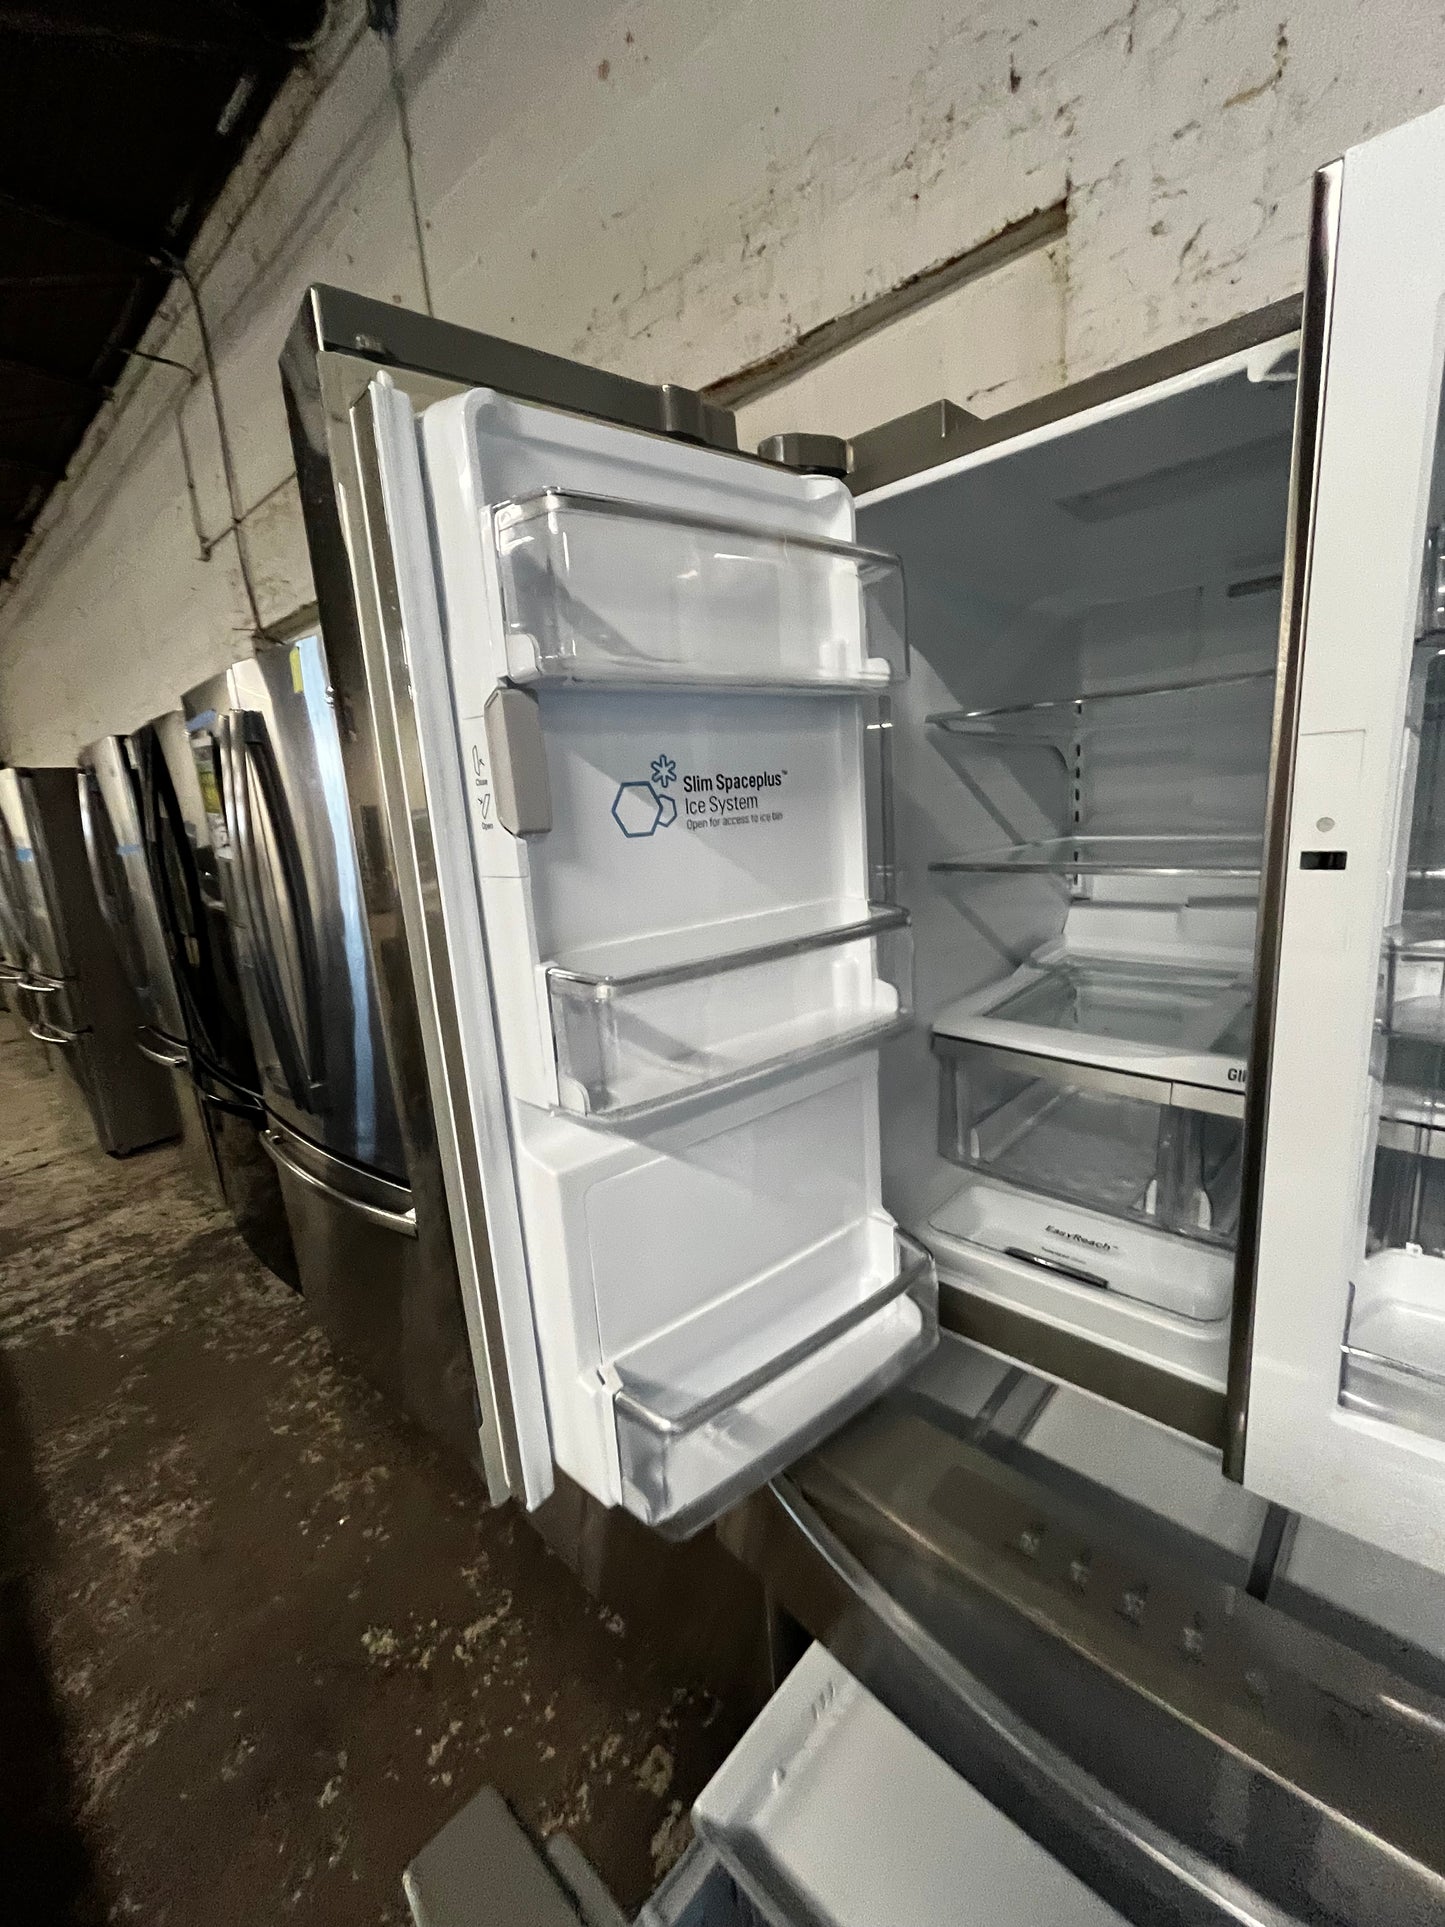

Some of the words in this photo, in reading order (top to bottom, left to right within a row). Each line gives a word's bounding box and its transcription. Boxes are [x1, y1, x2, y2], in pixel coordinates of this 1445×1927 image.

[683, 775, 713, 793] Slim
[685, 797, 706, 815] Ice
[709, 795, 758, 815] System
[686, 819, 708, 830] Open
[709, 817, 720, 827] for
[722, 815, 750, 826] access
[750, 814, 759, 823] to
[1045, 1224, 1118, 1251] EasyReach
